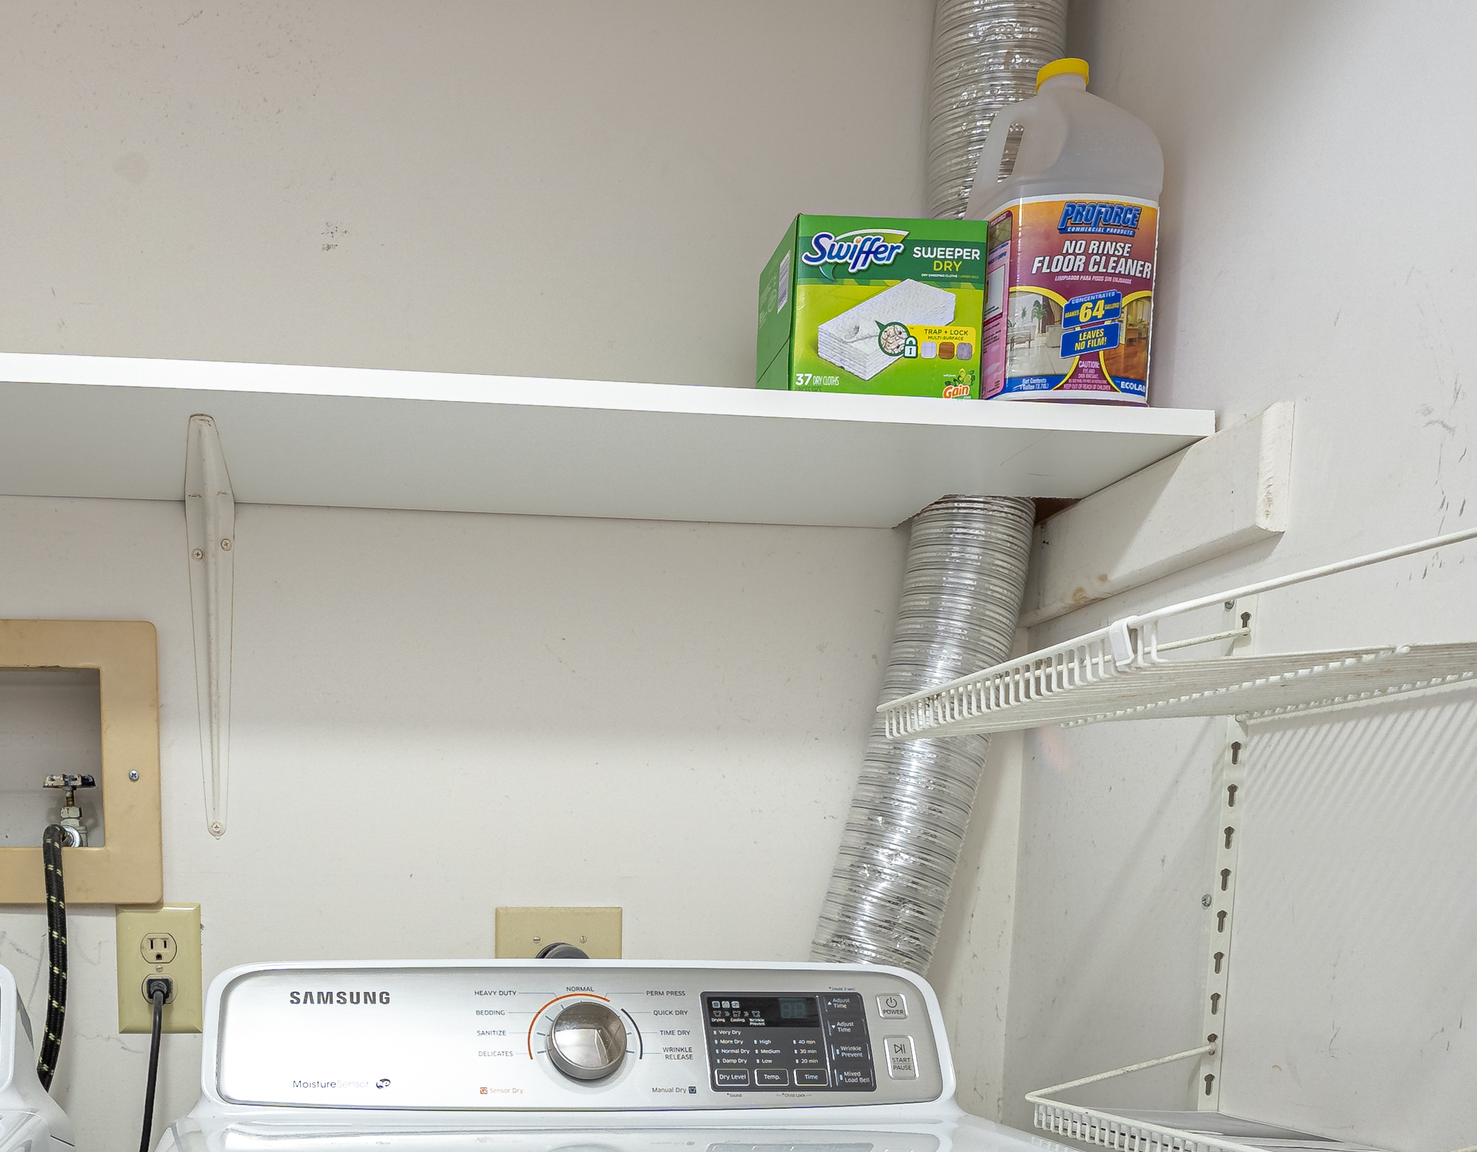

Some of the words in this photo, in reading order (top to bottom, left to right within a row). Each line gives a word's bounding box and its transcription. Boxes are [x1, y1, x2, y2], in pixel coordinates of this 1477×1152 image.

[1058, 202, 1142, 230] PROFORCE
[1106, 228, 1134, 236] PRODUCTS
[802, 232, 904, 272] Swiffer
[912, 246, 981, 261] SWEEPER
[1062, 240, 1086, 254] NO
[1088, 240, 1132, 257] RINSE
[933, 260, 963, 272] DRY
[1031, 255, 1087, 274] FLOOR
[1088, 255, 1153, 279] CLEANER
[1071, 291, 1116, 304] CONCENTRATED
[1079, 299, 1105, 322] 64
[1079, 328, 1104, 341] LEAVES
[1075, 341, 1086, 351] NO
[1087, 337, 1107, 348] FILM!
[795, 373, 812, 386] 37
[812, 375, 822, 386] DRY
[822, 375, 840, 386] CLOTHS
[943, 384, 969, 398] Gain
[289, 990, 391, 1005] SAMSUNG
[512, 1087, 523, 1095] Dry
